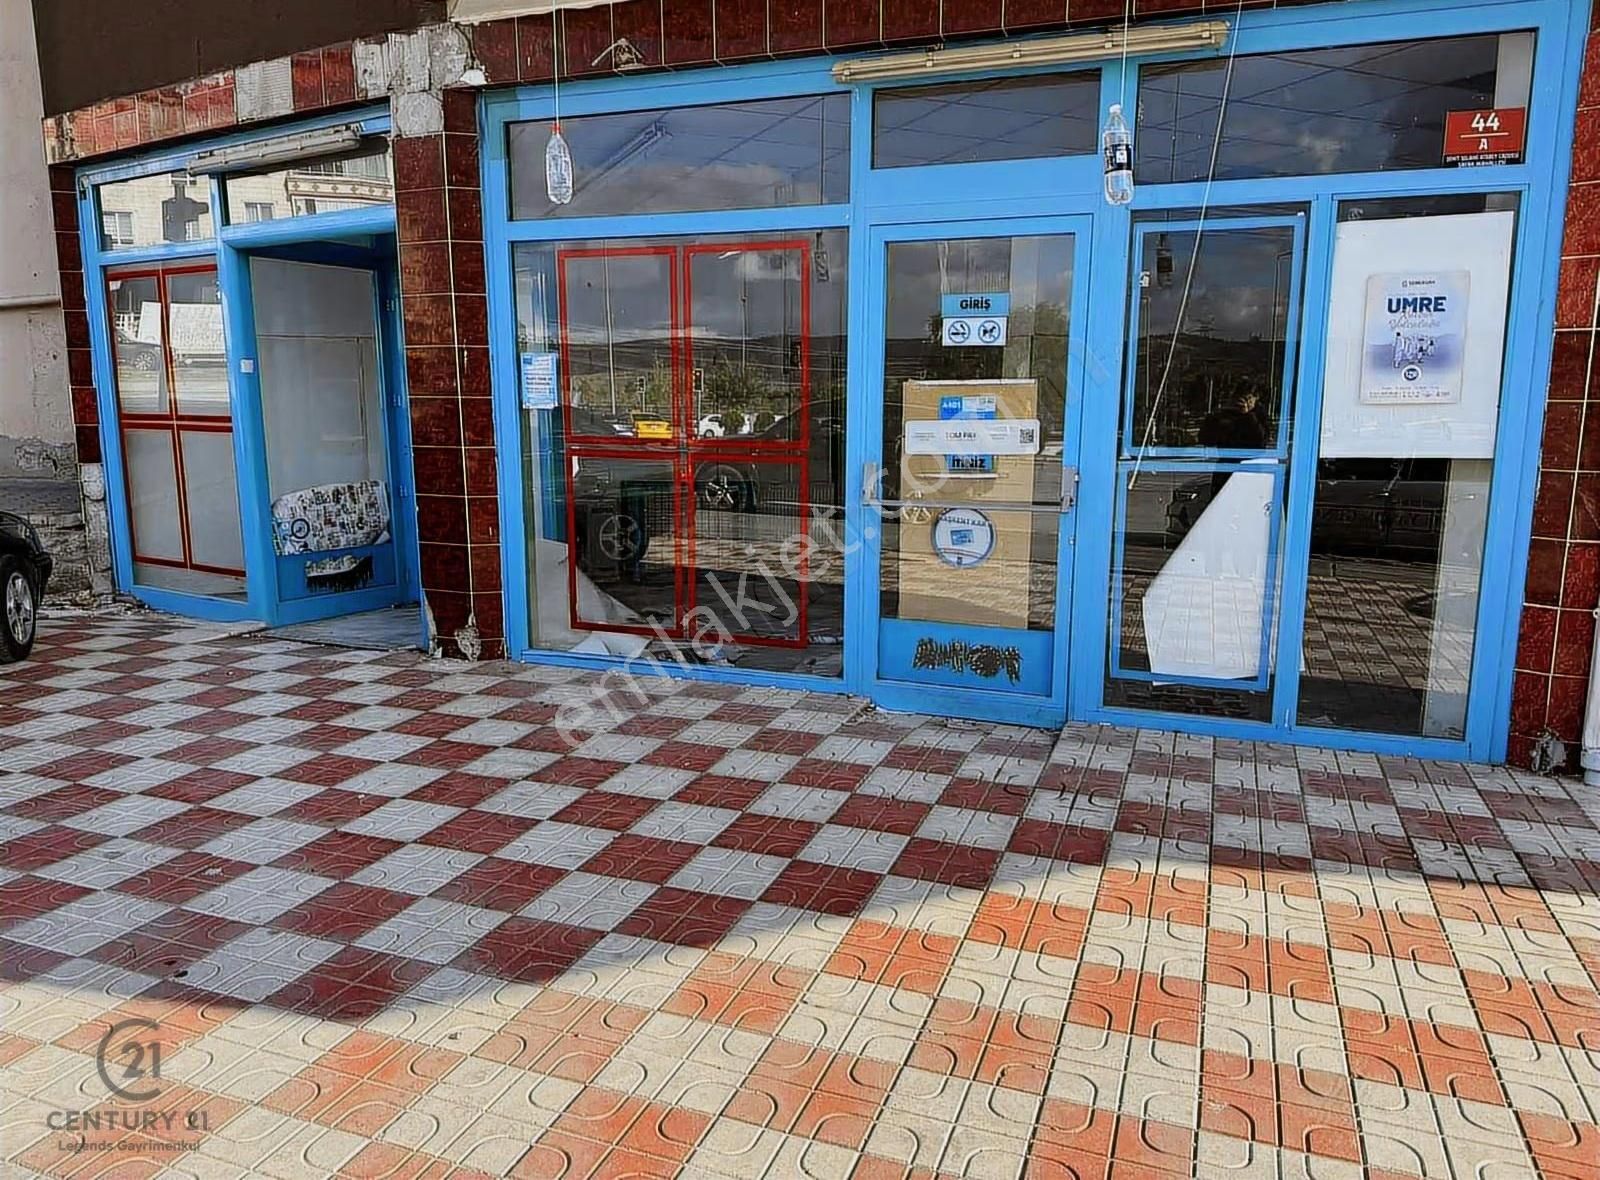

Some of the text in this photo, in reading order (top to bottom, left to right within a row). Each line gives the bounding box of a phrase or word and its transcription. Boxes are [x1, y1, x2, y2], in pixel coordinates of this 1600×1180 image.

[1471, 112, 1500, 132] 44
[1478, 138, 1488, 150] A
[959, 296, 991, 311] GİRİŞ
[1387, 296, 1447, 313] UMRE
